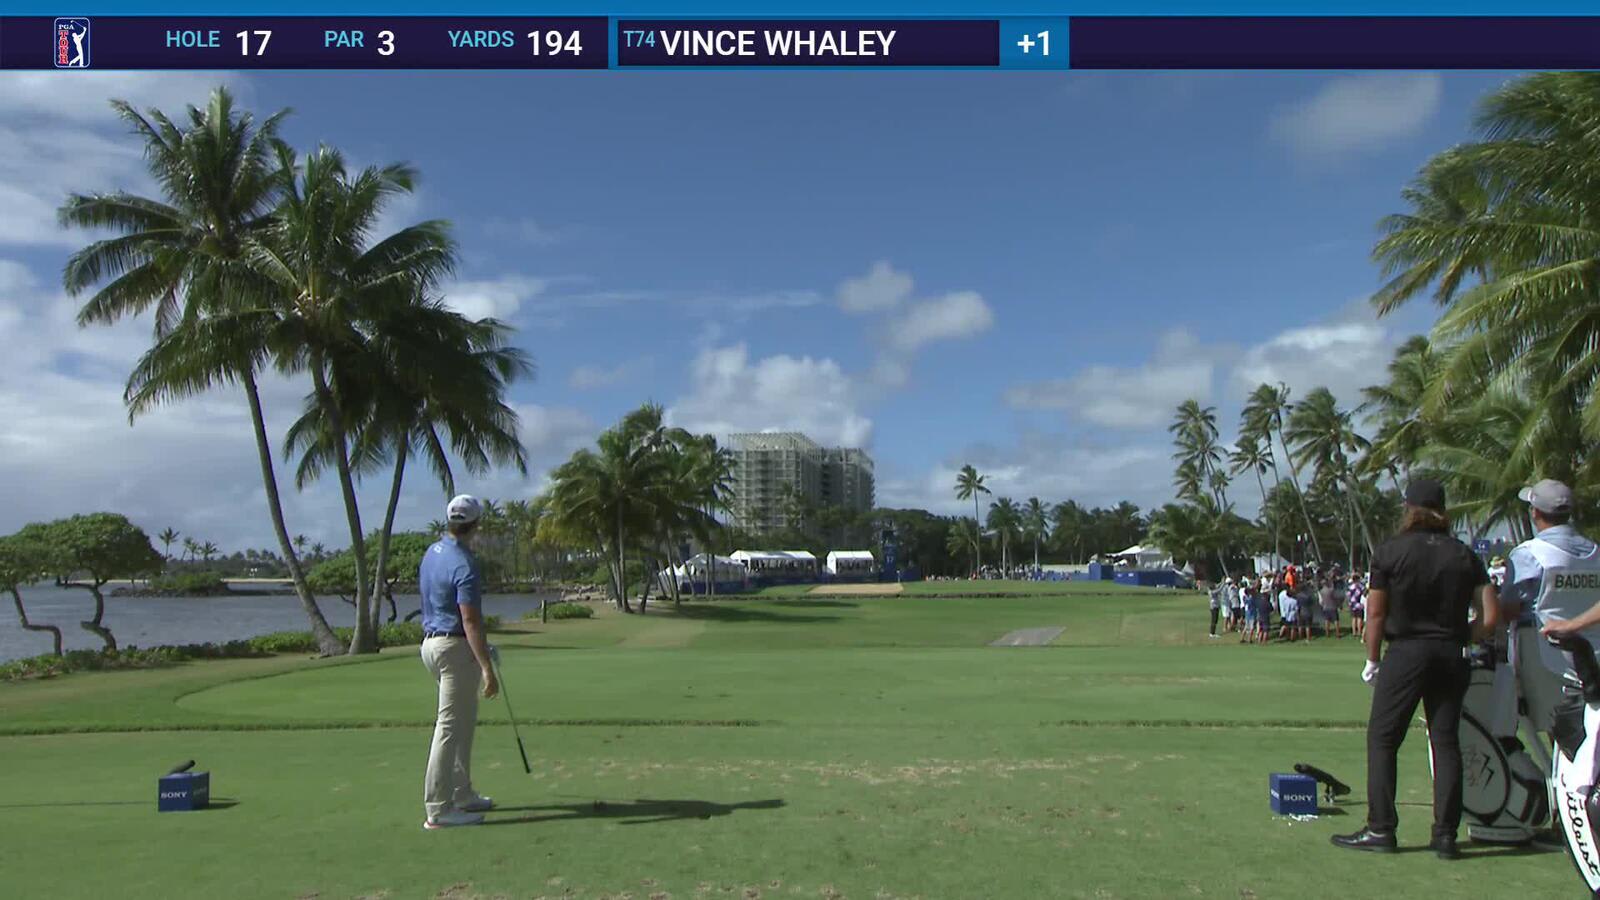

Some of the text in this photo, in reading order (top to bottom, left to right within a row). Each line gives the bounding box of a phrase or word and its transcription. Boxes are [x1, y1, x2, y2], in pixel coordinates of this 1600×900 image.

[1555, 574, 1600, 589] BADDEL
[160, 791, 187, 799] SONY
[1283, 794, 1313, 802] SONY
[1561, 773, 1600, 877] itleist
